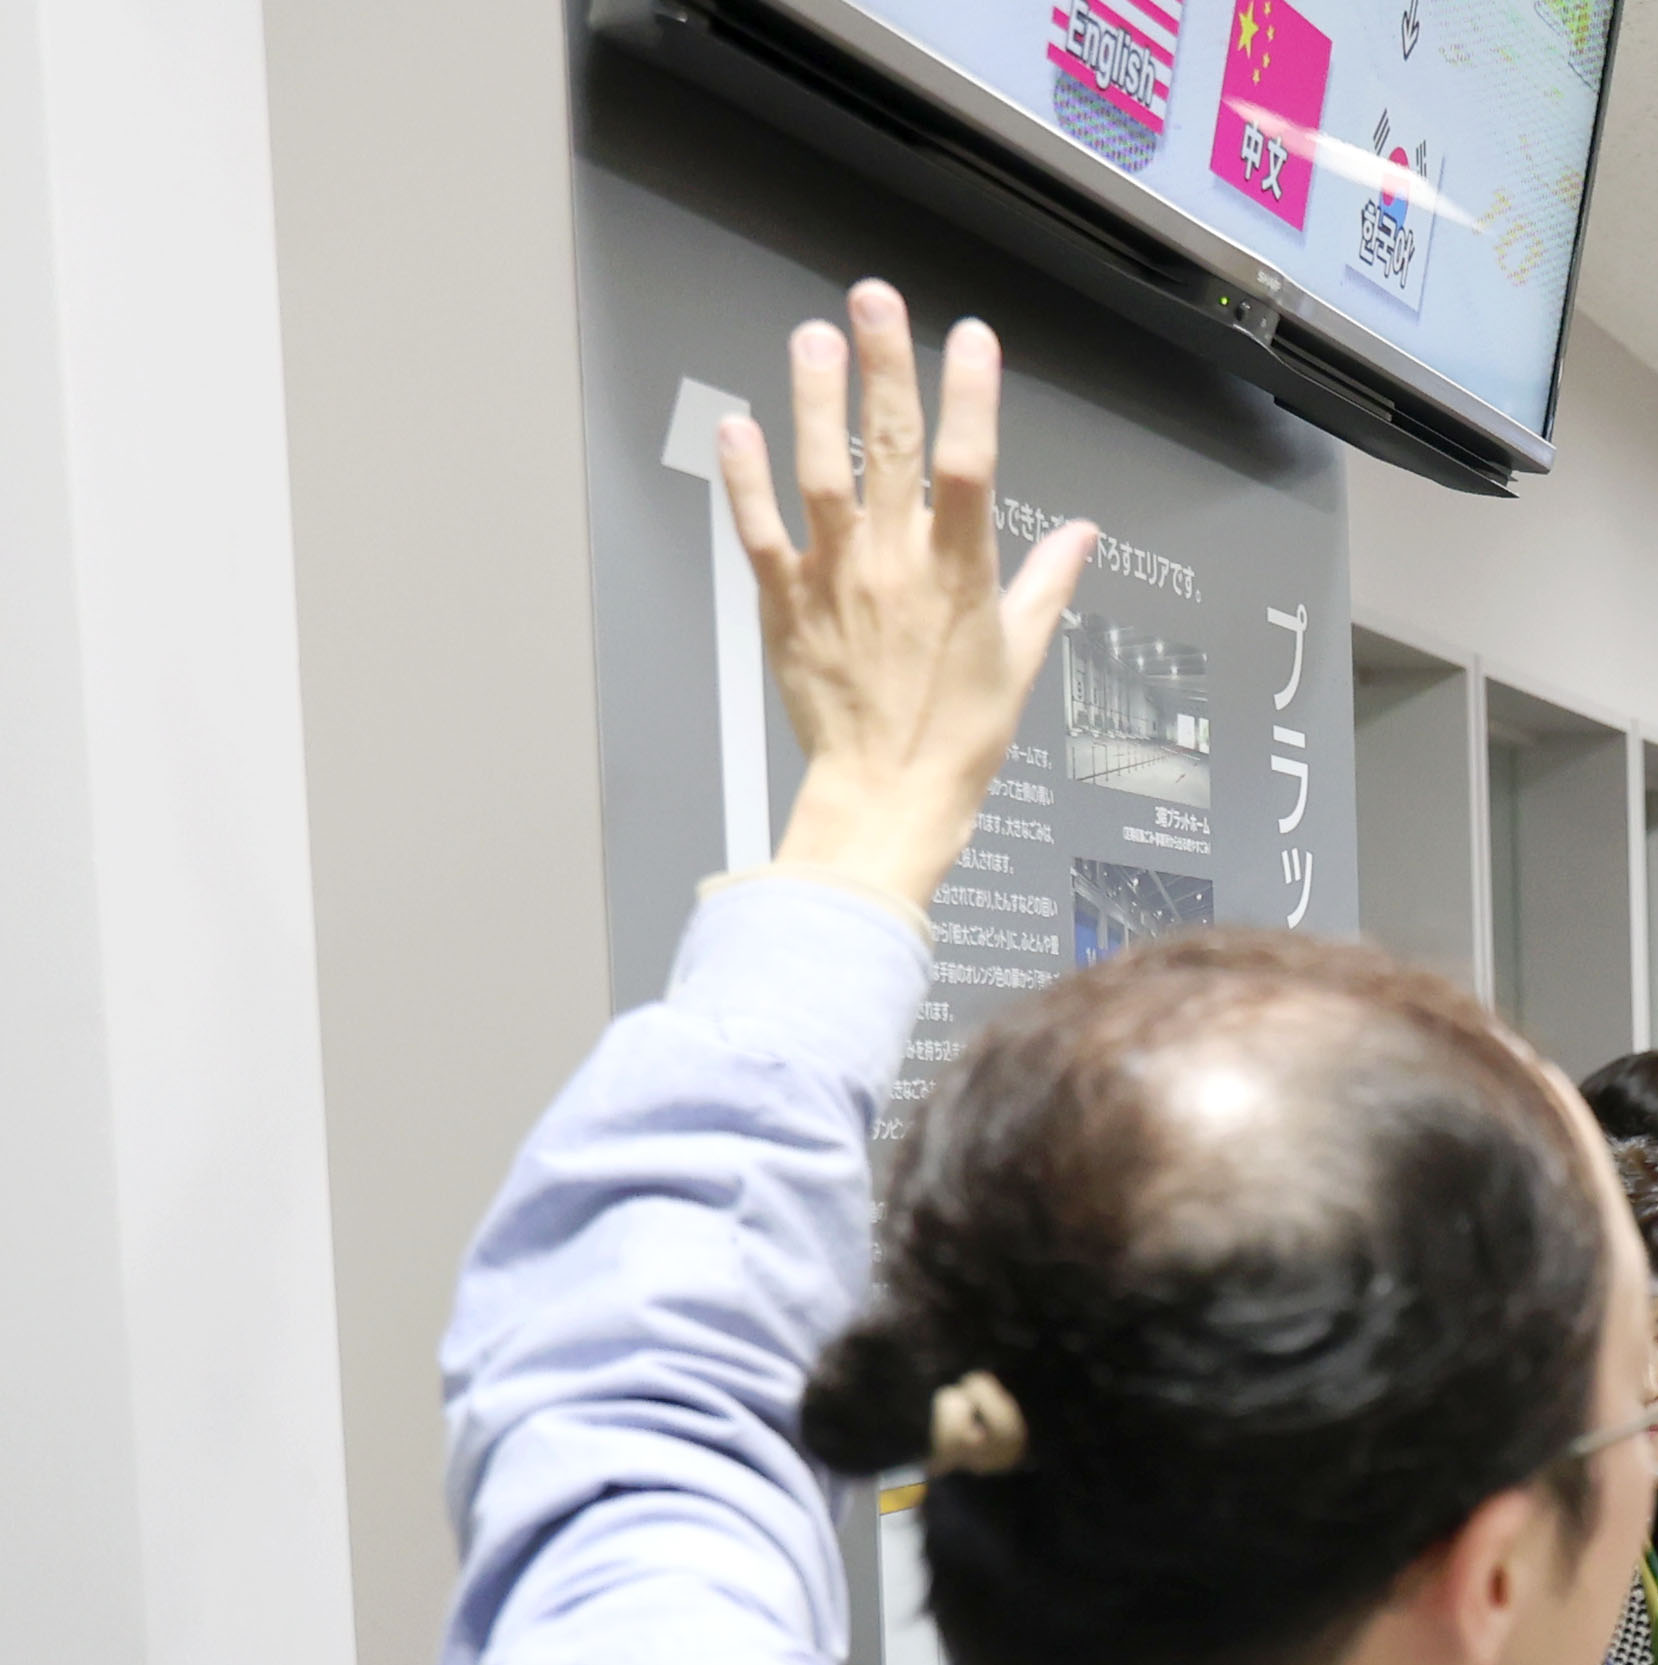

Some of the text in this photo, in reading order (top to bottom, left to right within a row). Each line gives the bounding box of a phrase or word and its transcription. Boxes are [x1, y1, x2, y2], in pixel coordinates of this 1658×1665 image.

[1064, 0, 1157, 107] English
[1240, 118, 1288, 201] 中文
[1359, 199, 1415, 288] 한국어
